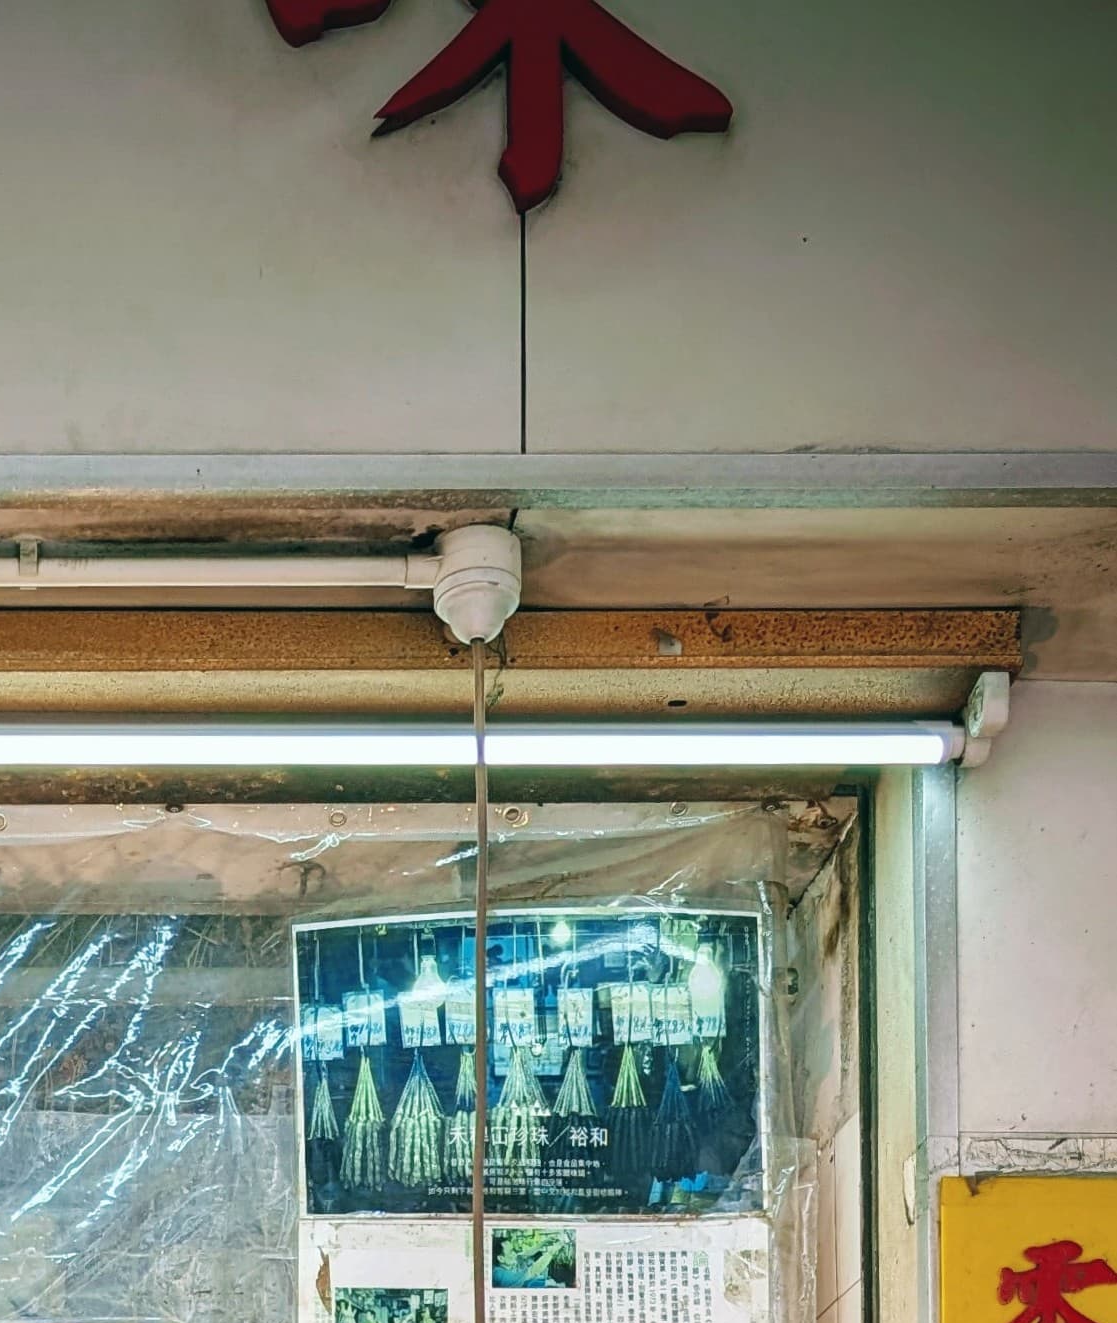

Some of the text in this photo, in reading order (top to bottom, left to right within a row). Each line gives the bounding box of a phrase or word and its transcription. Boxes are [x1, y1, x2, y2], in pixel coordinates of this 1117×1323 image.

[449, 1126, 609, 1147] 禾冚珍珠／裕和
